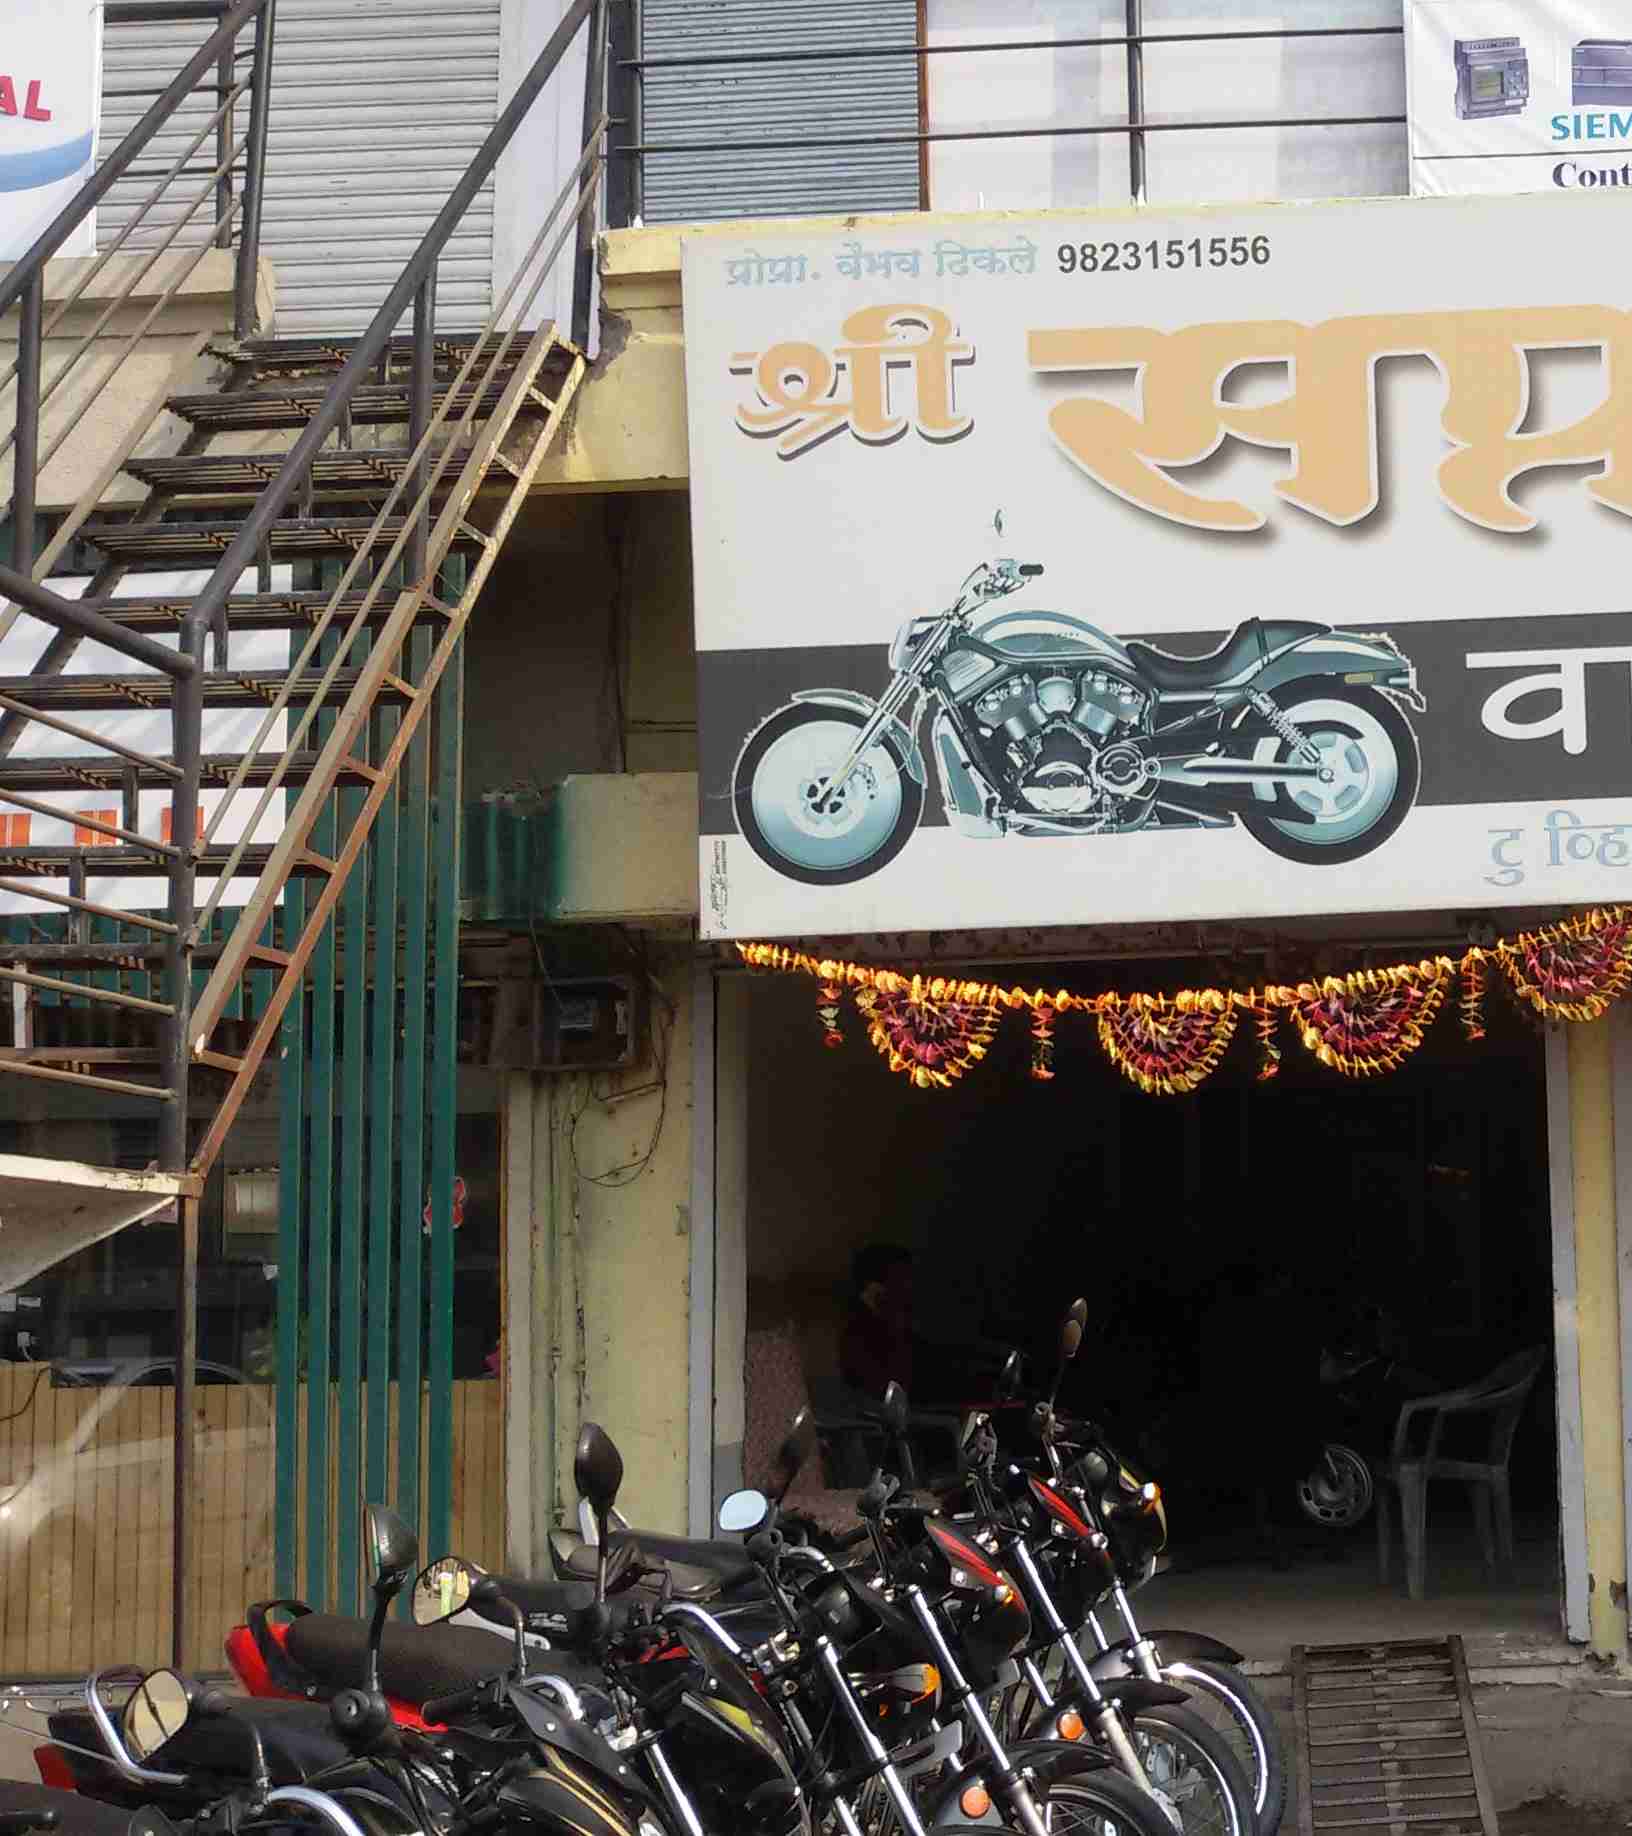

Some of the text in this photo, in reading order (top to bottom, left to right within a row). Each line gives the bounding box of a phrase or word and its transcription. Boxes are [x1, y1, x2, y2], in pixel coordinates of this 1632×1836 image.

[834, 240, 923, 280] वैभव
[1056, 235, 1272, 274] 9823151556
[728, 301, 977, 461] श्री
[1483, 828, 1525, 887] टु
